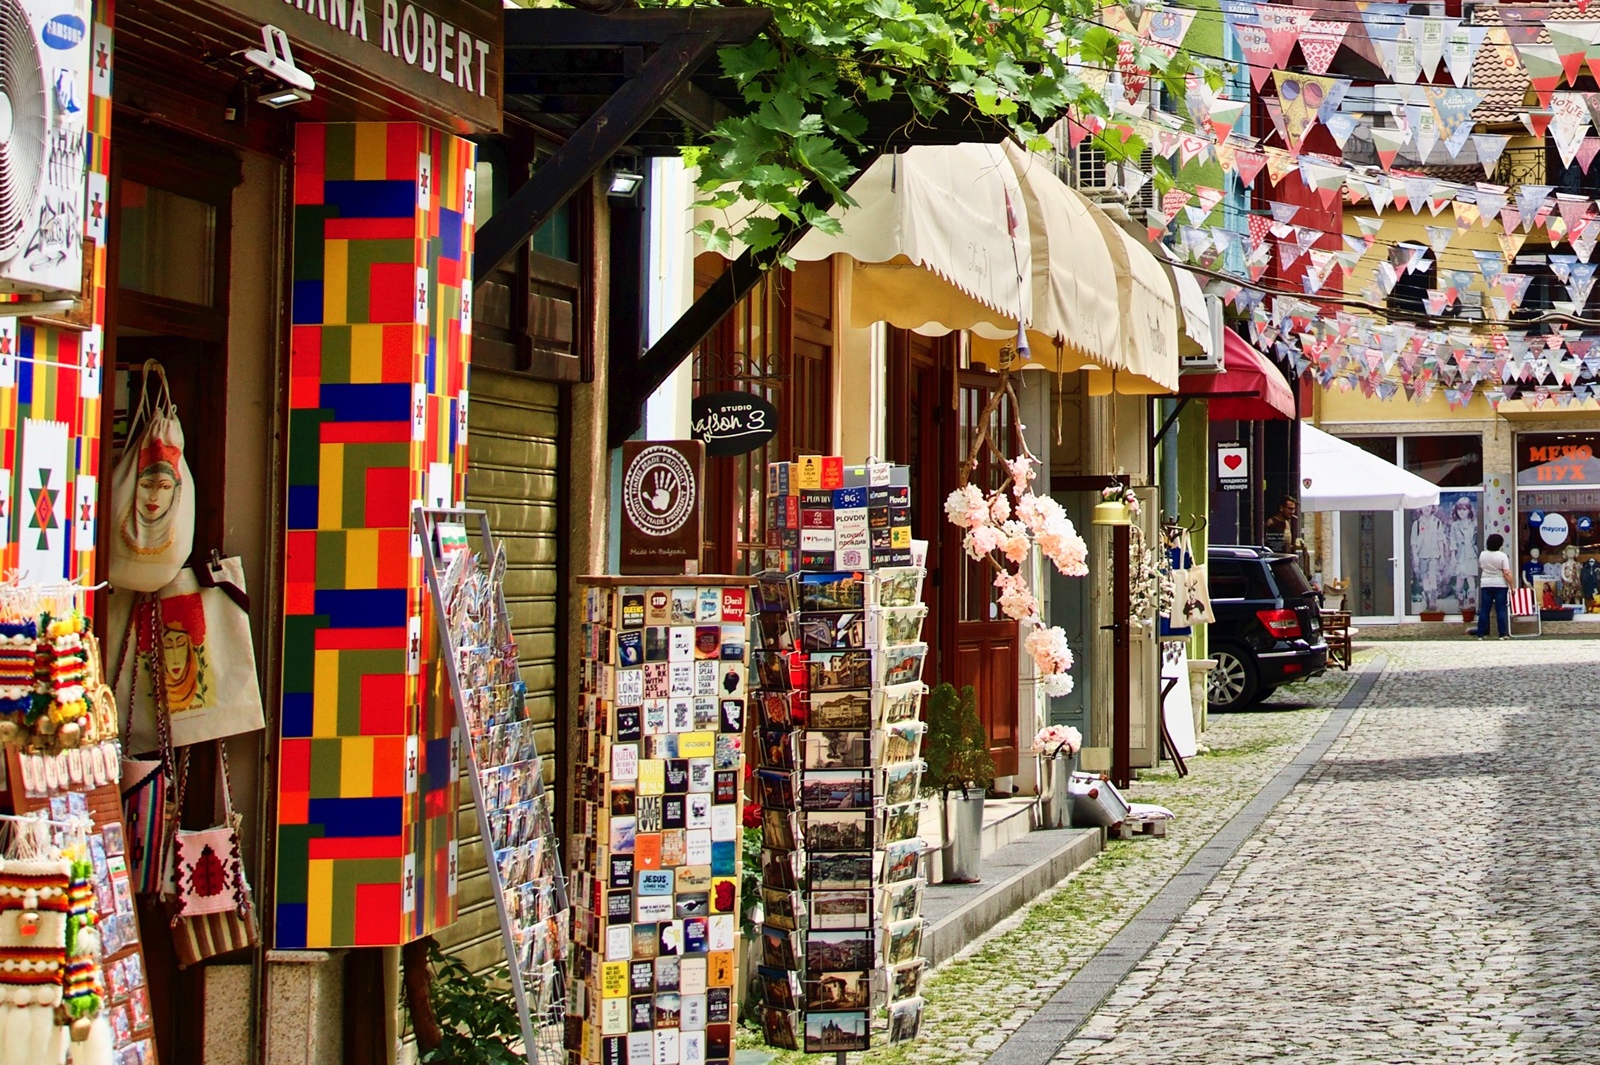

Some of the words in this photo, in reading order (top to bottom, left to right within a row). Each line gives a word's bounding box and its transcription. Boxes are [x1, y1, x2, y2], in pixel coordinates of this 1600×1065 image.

[47, 19, 83, 44] SAMSUNG
[721, 404, 752, 413] STUDIO
[747, 410, 765, 429] 3
[1529, 445, 1593, 462] МЕЧО
[632, 471, 645, 494] HAND
[641, 457, 660, 471] MADE
[662, 456, 686, 486] PRODUCT
[1537, 465, 1585, 481] ПУХ
[806, 494, 831, 504] PLOVDIV
[889, 494, 908, 504] Plovdiv
[632, 497, 647, 520] HAND
[645, 515, 665, 525] MADE
[666, 492, 687, 522] PRODUCT
[836, 513, 866, 523] PLOVDIV
[840, 532, 865, 541] PLOVDIV
[839, 538, 866, 547] ПЛОВДИВ
[653, 596, 667, 606] STOP
[722, 605, 744, 617] Worry
[619, 682, 638, 693] LONG
[619, 695, 642, 705] STORY
[615, 751, 636, 760] QUEENS
[617, 767, 634, 776] JUNE
[637, 796, 660, 809] LIVE
[637, 808, 660, 819] LAUGH
[643, 875, 667, 884] JESUS
